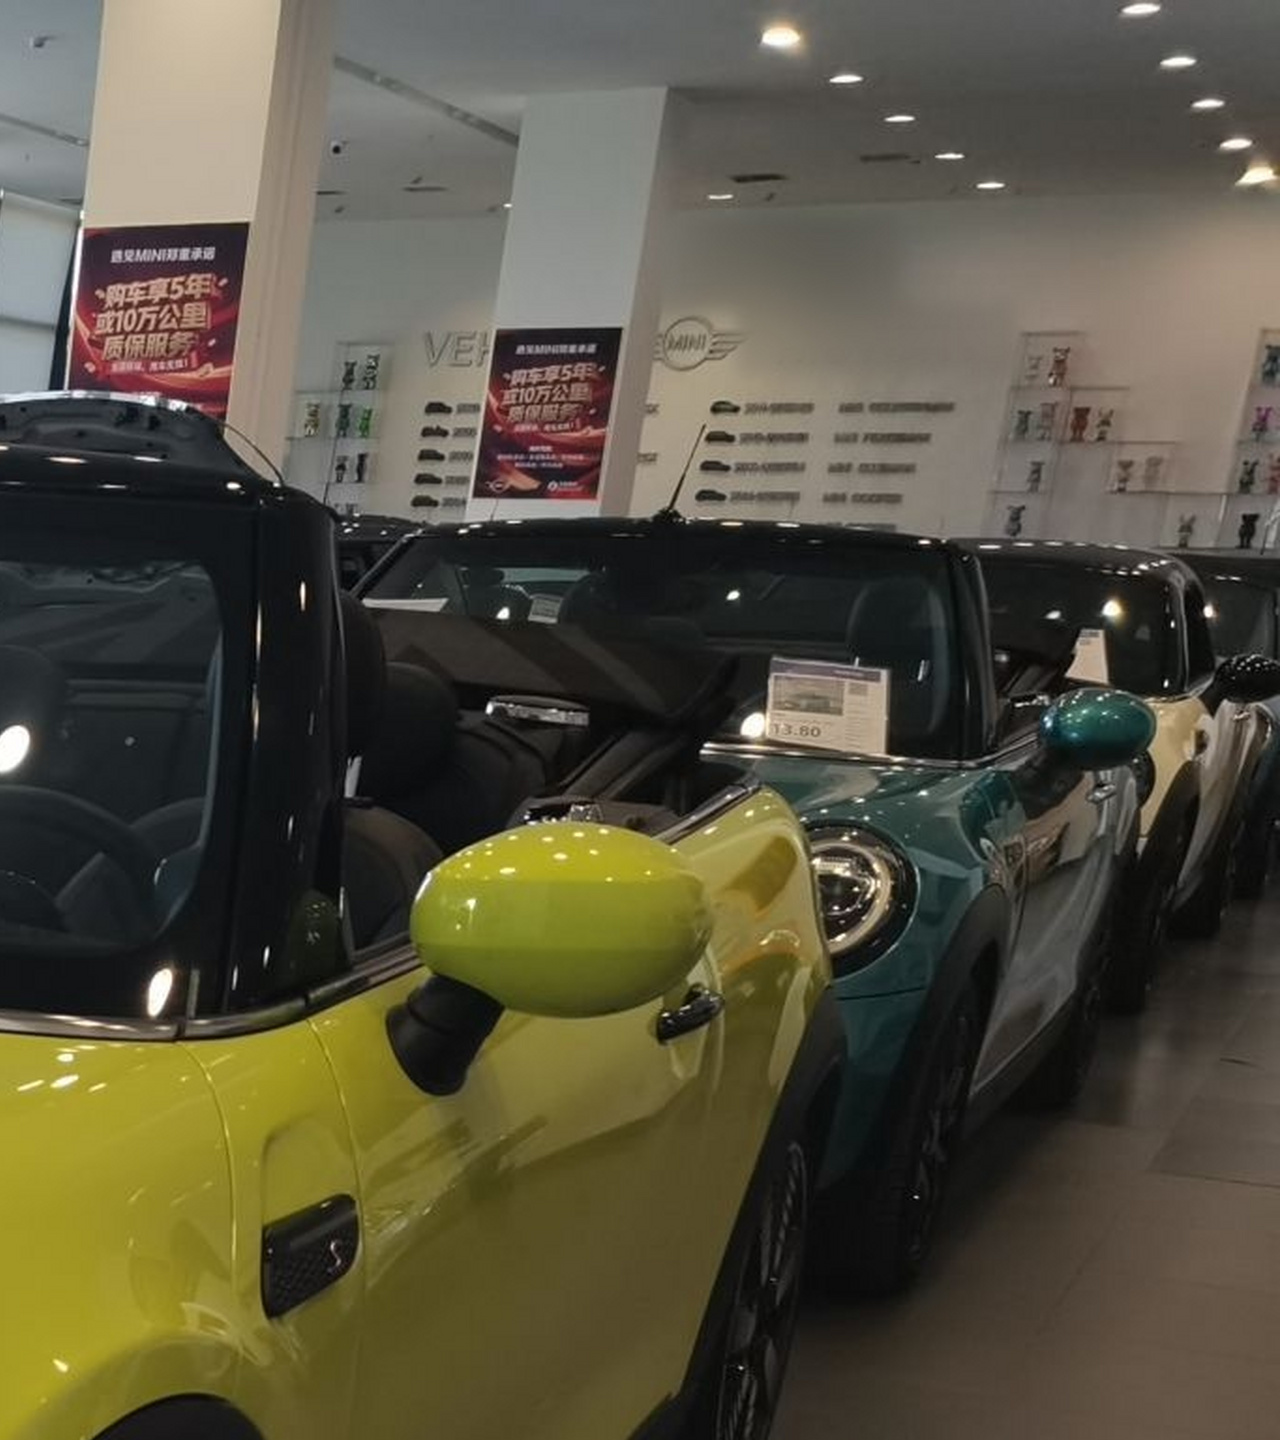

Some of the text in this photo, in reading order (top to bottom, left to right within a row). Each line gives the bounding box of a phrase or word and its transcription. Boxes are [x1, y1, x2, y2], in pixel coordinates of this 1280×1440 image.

[103, 273, 212, 310] 购车享5年
[94, 301, 207, 336] 或10万公里
[102, 331, 195, 361] 质保服务
[667, 333, 707, 351] MINI
[509, 362, 592, 386] 购车享5年
